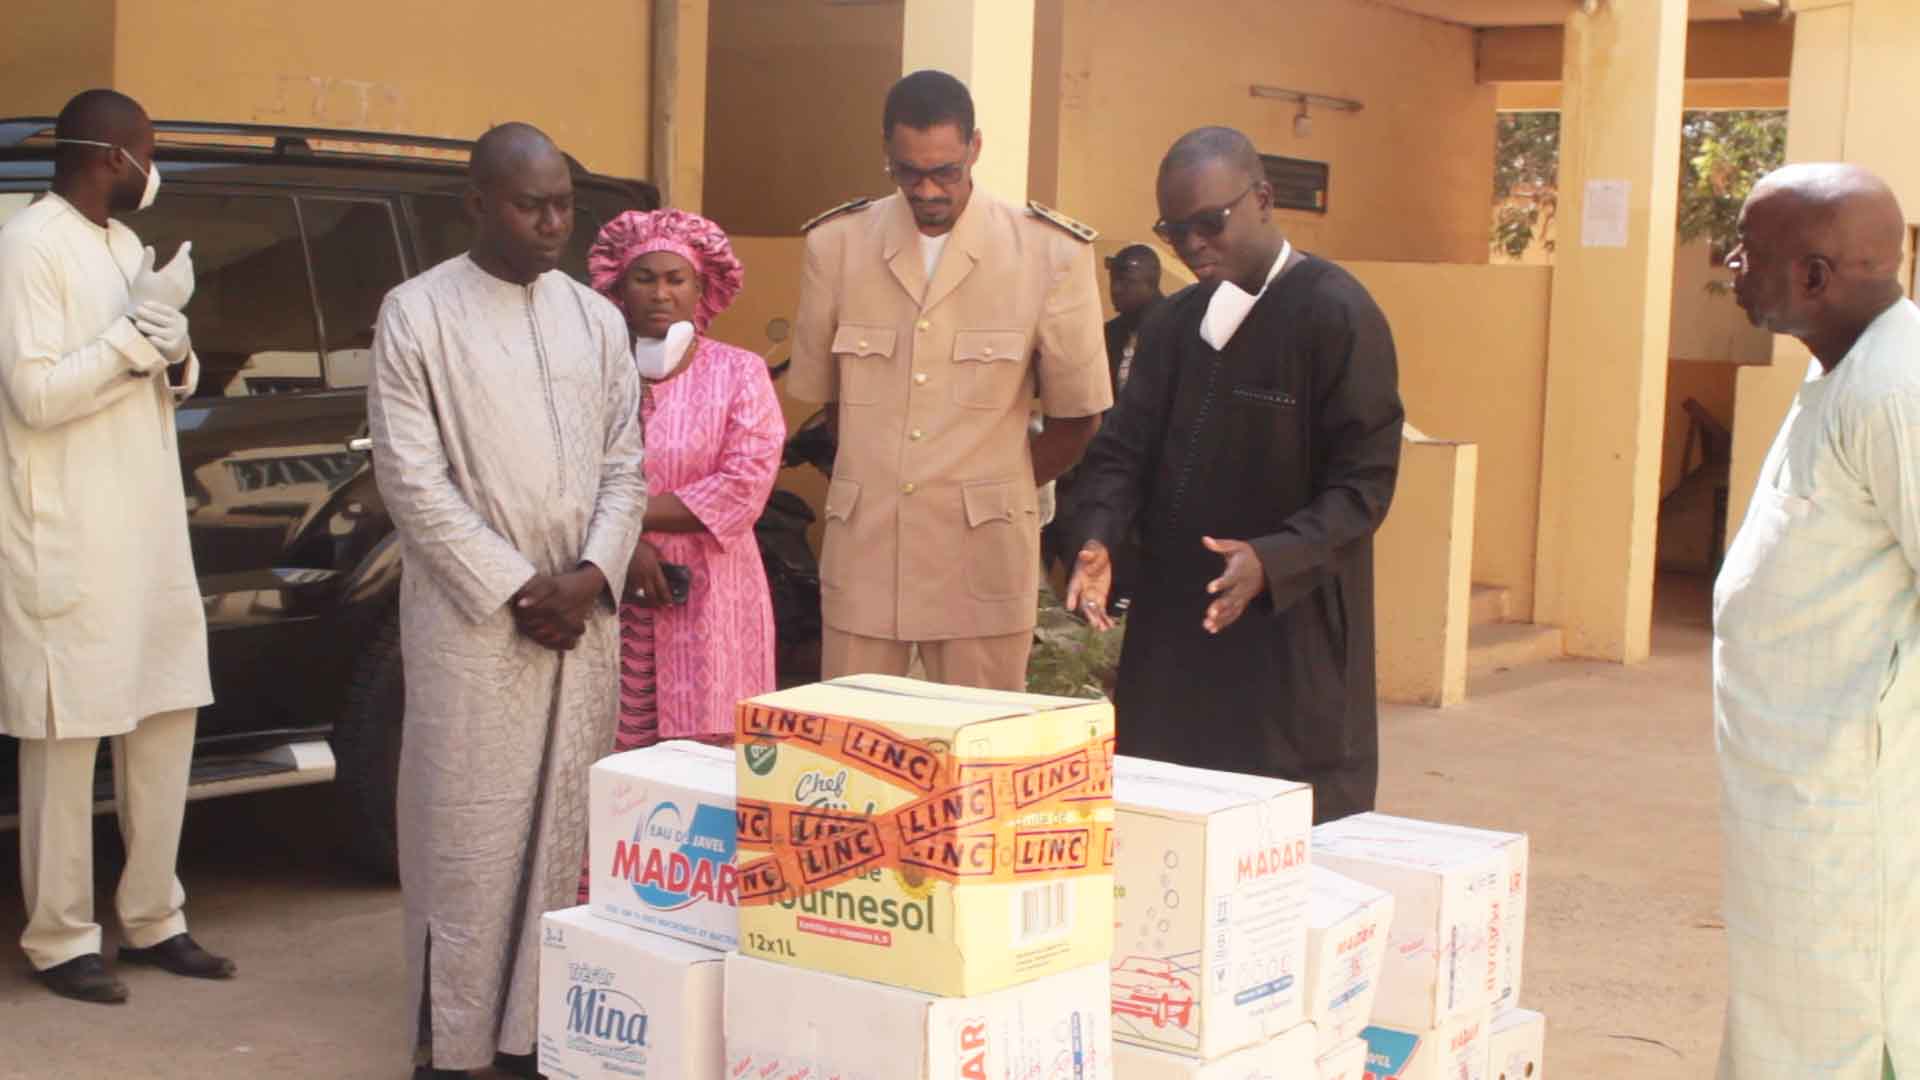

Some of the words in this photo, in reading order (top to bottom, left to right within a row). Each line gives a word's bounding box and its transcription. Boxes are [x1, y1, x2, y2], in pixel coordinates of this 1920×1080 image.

[751, 708, 817, 735] LINC
[853, 731, 928, 780] LINC
[795, 770, 848, 801] Chef
[1023, 760, 1081, 797] LINC
[736, 811, 765, 836] NC
[909, 788, 985, 823] LINC
[807, 829, 873, 873] LINC
[1022, 837, 1082, 865] LINC
[1237, 839, 1306, 883] MADAR
[611, 839, 738, 907] MADAR
[768, 883, 935, 934] ournesol
[748, 932, 797, 958] 12x1L
[566, 984, 649, 1047] Mina
